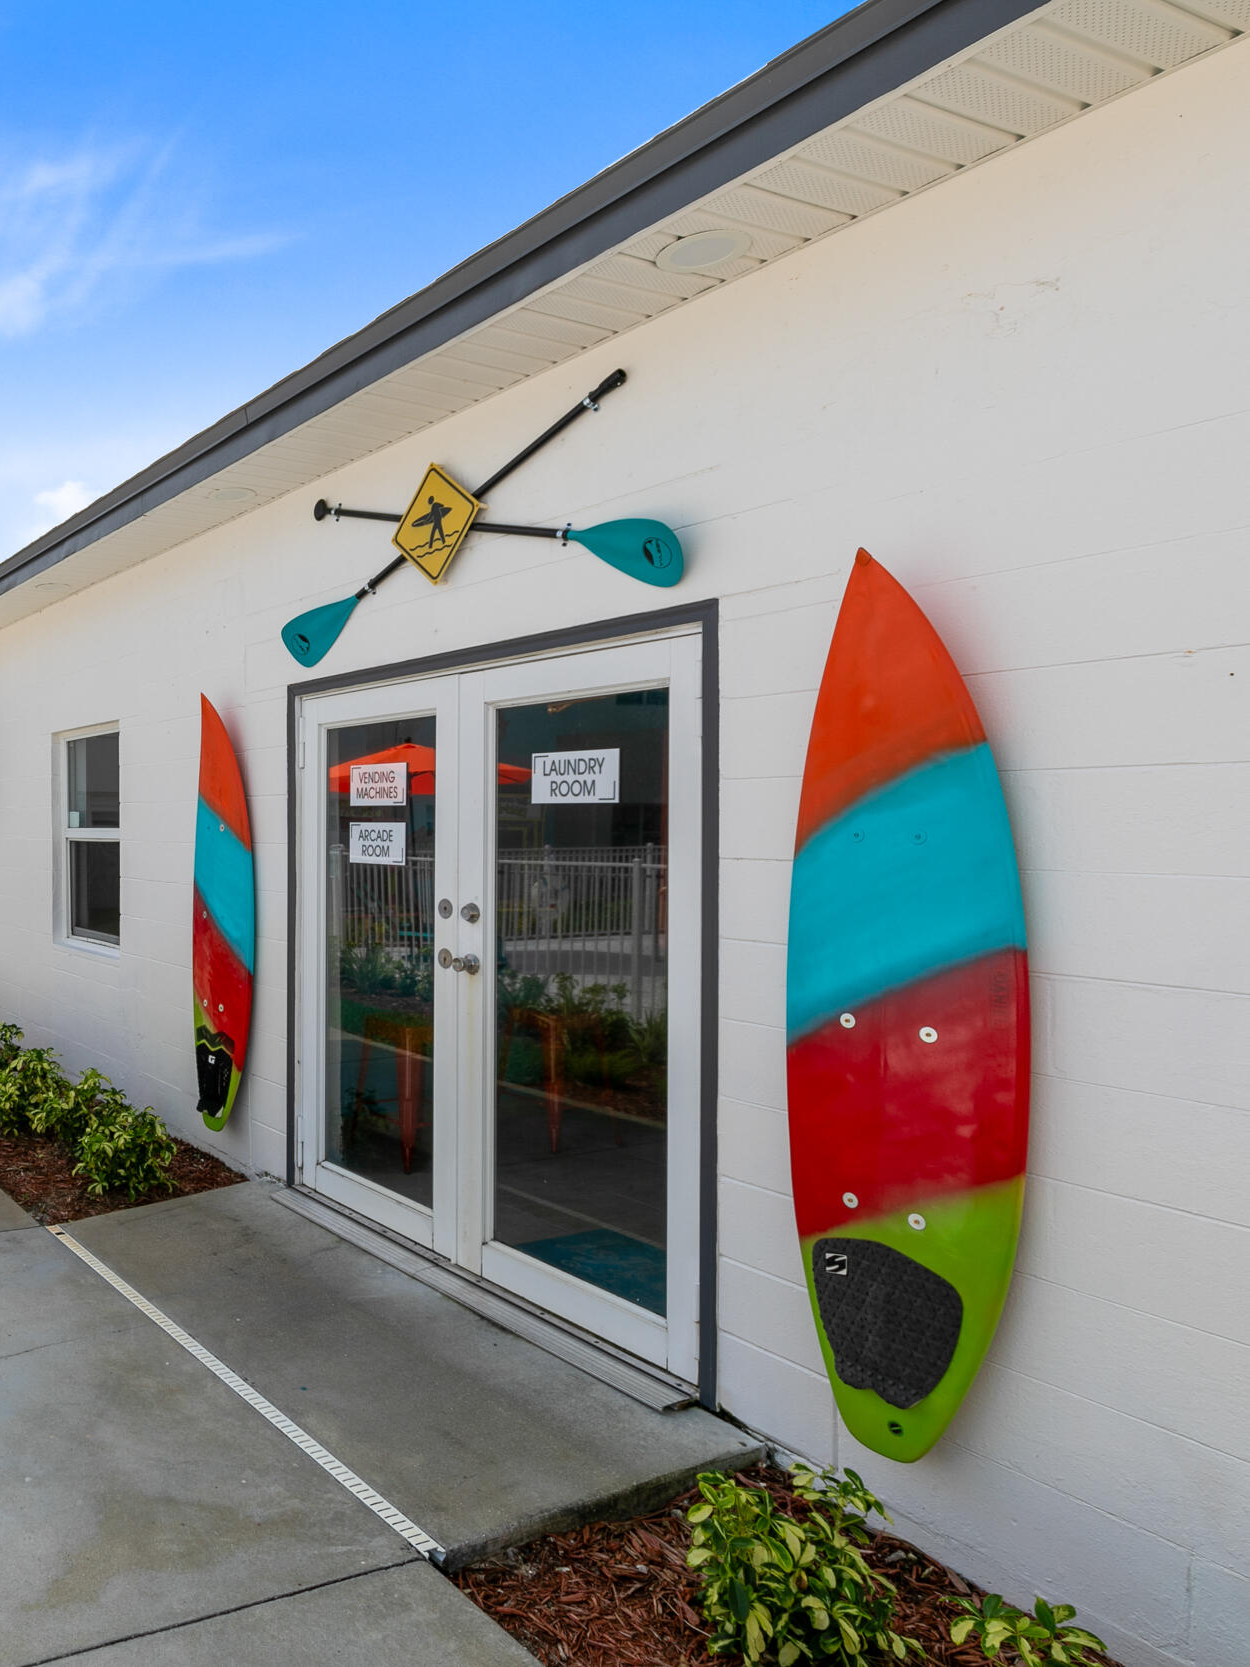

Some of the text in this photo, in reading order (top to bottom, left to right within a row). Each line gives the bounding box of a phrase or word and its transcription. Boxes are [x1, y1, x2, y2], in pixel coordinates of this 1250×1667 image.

[542, 756, 606, 777] LAUNDRY
[358, 770, 396, 784] VENDING
[356, 786, 398, 799] MACHINES
[550, 779, 596, 797] ROOM
[358, 829, 394, 842] ARCADE
[361, 844, 390, 857] ROOM
